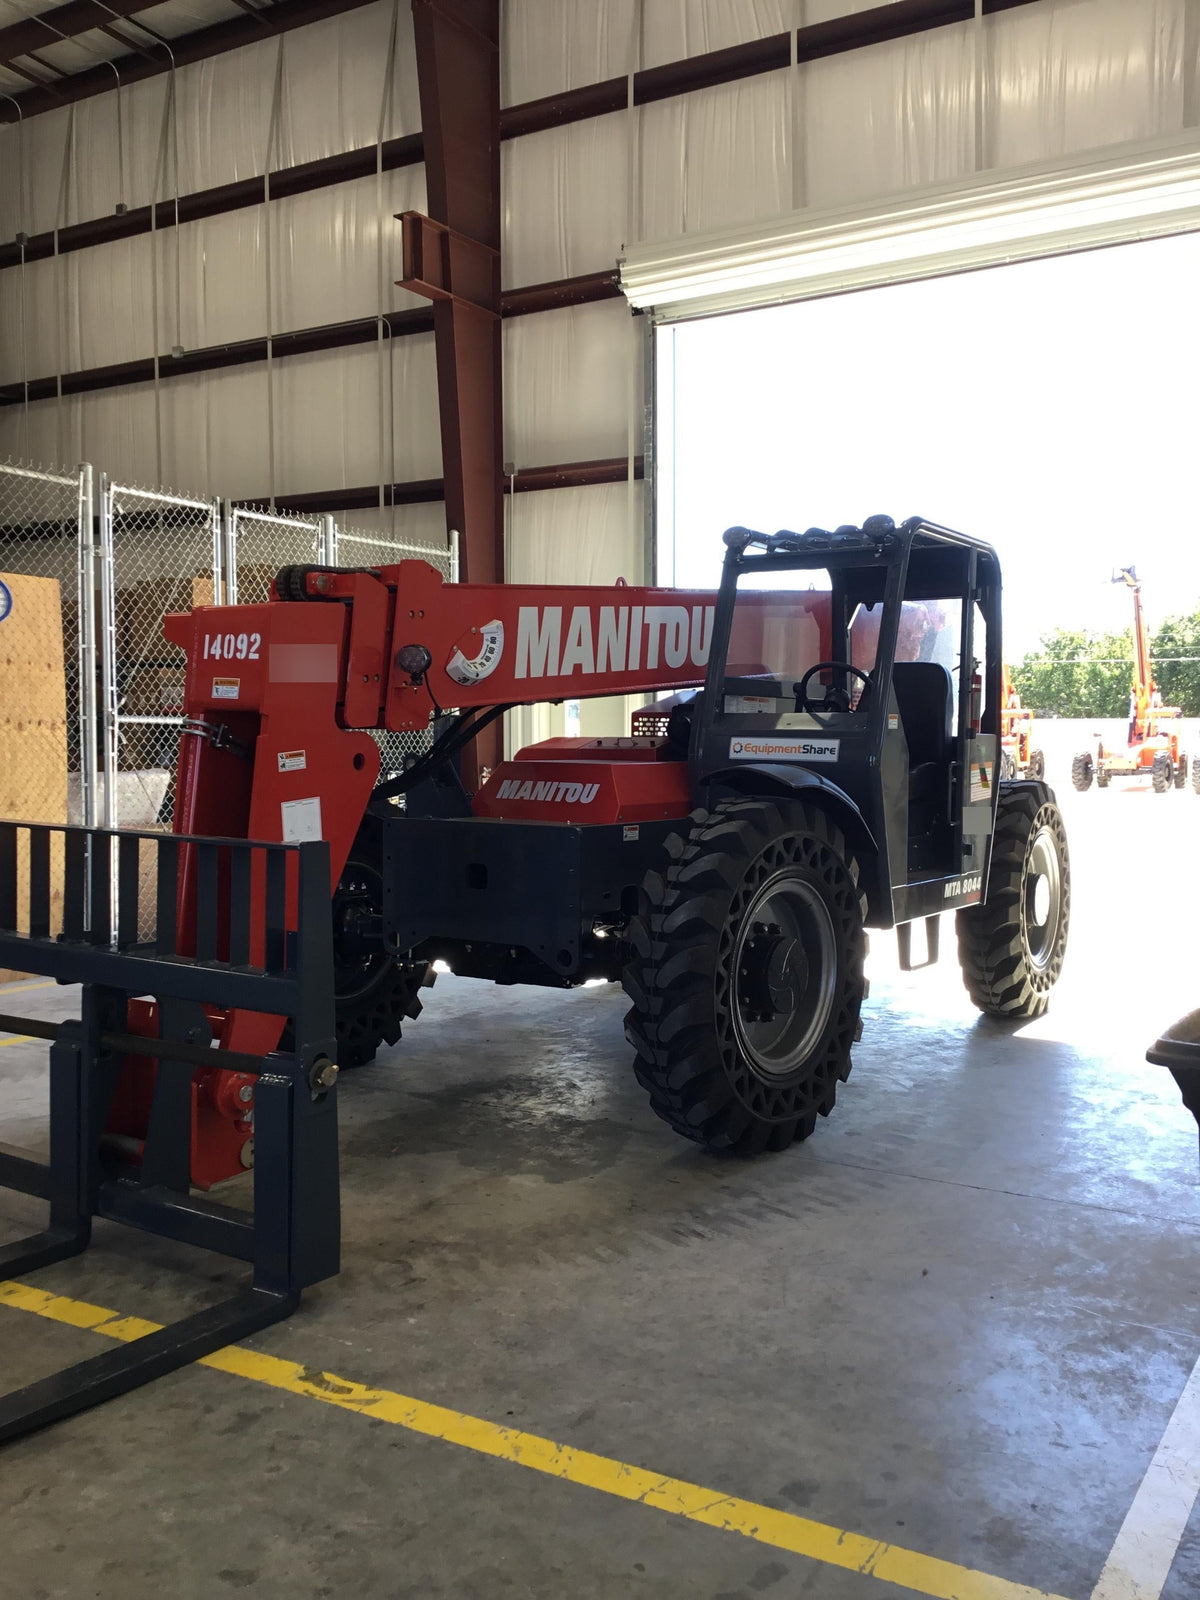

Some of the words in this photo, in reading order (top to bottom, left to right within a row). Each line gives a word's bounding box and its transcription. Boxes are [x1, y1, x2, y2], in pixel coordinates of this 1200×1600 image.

[203, 633, 261, 660] 14092
[514, 606, 714, 679] MANITOU
[744, 743, 837, 756] EquipmentShare
[496, 780, 600, 804] MANITOU
[944, 880, 961, 898] MTA
[962, 877, 982, 894] 8044
